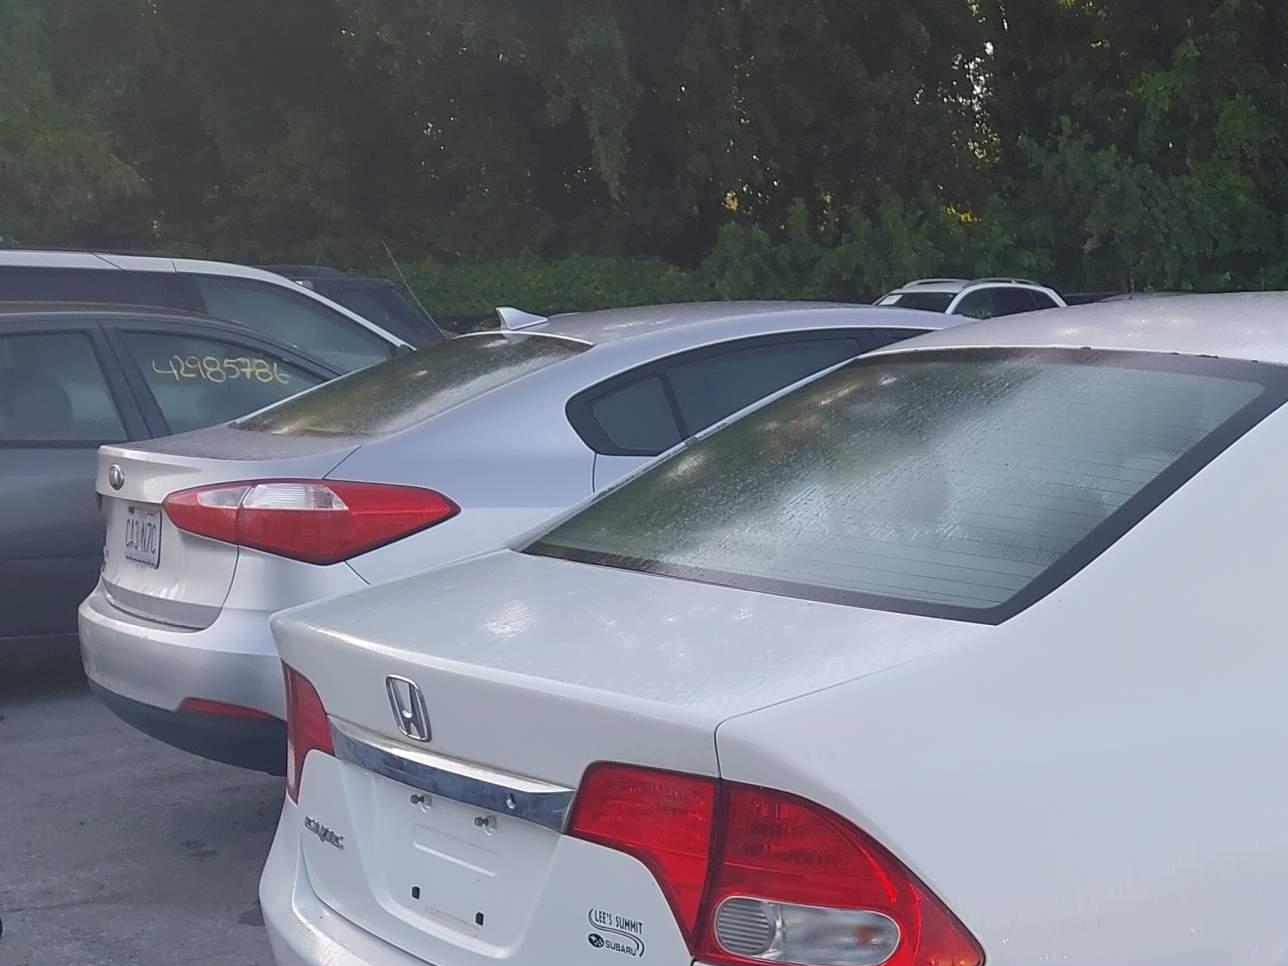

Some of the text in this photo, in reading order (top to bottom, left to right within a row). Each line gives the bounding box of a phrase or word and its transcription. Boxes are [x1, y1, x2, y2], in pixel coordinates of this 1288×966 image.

[151, 354, 290, 385] 42985786
[594, 909, 644, 935] LEE'S SUMMIT
[605, 940, 637, 957] SUBARU
